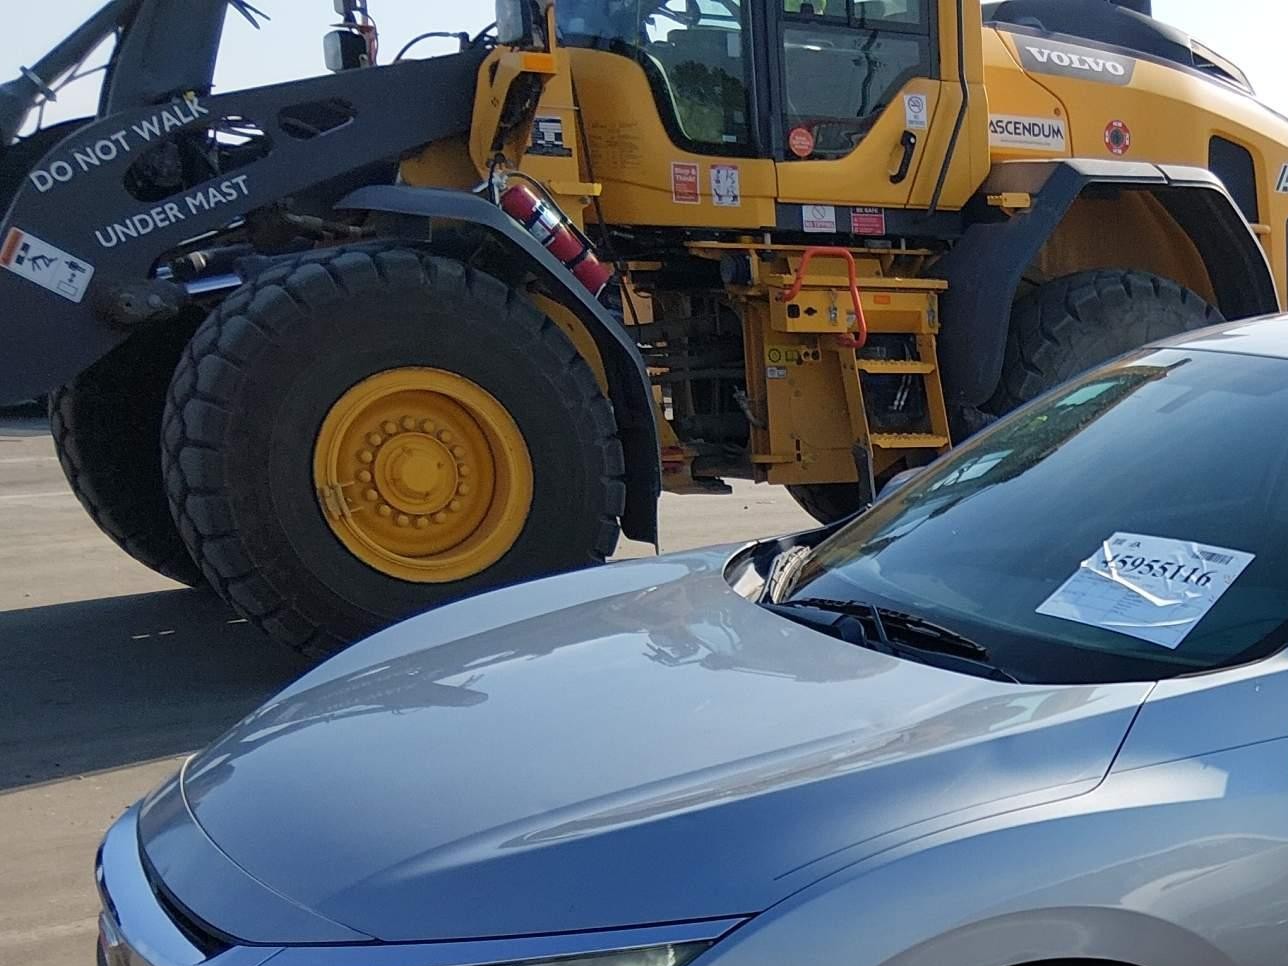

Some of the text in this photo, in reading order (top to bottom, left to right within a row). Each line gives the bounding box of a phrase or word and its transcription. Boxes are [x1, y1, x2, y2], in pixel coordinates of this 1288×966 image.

[1025, 46, 1125, 76] VOLVO
[29, 96, 209, 193] DO NOT WALK
[988, 119, 1064, 140] ASCENDUM
[95, 175, 249, 247] UNDER MAST
